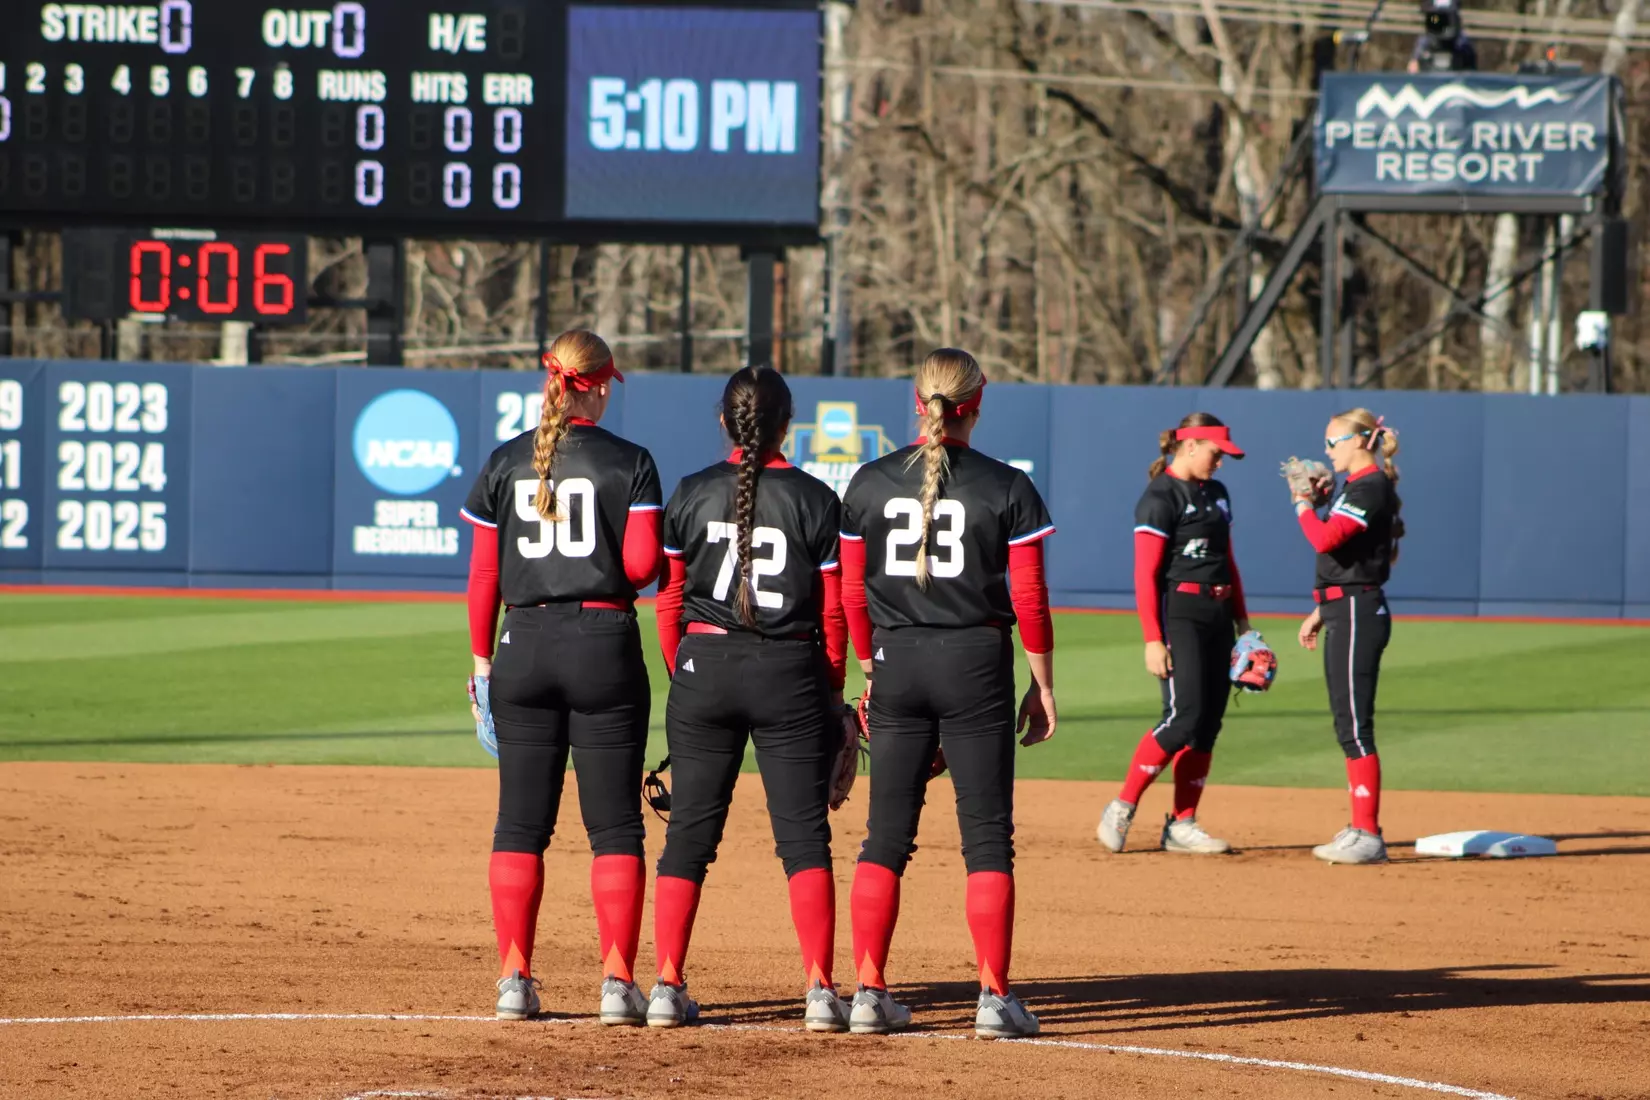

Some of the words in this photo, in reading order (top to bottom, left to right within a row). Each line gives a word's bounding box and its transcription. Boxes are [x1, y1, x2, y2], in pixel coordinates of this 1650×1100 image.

[41, 4, 159, 42] STRIKE
[160, 0, 192, 53] 0
[262, 9, 332, 48] OUT
[332, 2, 366, 57] 0
[428, 13, 487, 54] H/E
[25, 62, 47, 93] 2
[64, 63, 84, 94] 3
[111, 64, 131, 95] 4
[150, 65, 170, 96] 5
[188, 66, 208, 97] 6
[235, 67, 255, 98] 7
[273, 69, 293, 99] 8
[317, 70, 387, 101] RUNS
[410, 71, 468, 103] HITS
[482, 73, 534, 104] ERR
[356, 104, 385, 150] 0
[444, 106, 472, 152] 0
[494, 107, 522, 153] 0
[589, 76, 699, 151] 5:10
[710, 79, 797, 153] PM
[1325, 120, 1464, 149] PEARL
[1472, 122, 1597, 151] RIVER
[355, 160, 384, 206] 0
[443, 162, 472, 208] 0
[493, 163, 521, 209] 0
[1376, 153, 1544, 182] RESORT
[130, 240, 294, 315] 0:06
[58, 380, 168, 433] 2023
[496, 392, 545, 441] 20
[0, 439, 21, 490] 1
[57, 440, 168, 492] 2024
[363, 440, 456, 467] NCAA
[0, 499, 28, 549] 2
[56, 500, 167, 551] 2025
[374, 500, 438, 527] SUPER
[515, 478, 596, 559] 50
[884, 497, 965, 577] 23
[354, 526, 458, 555] REGIONALS
[707, 521, 787, 609] 72
